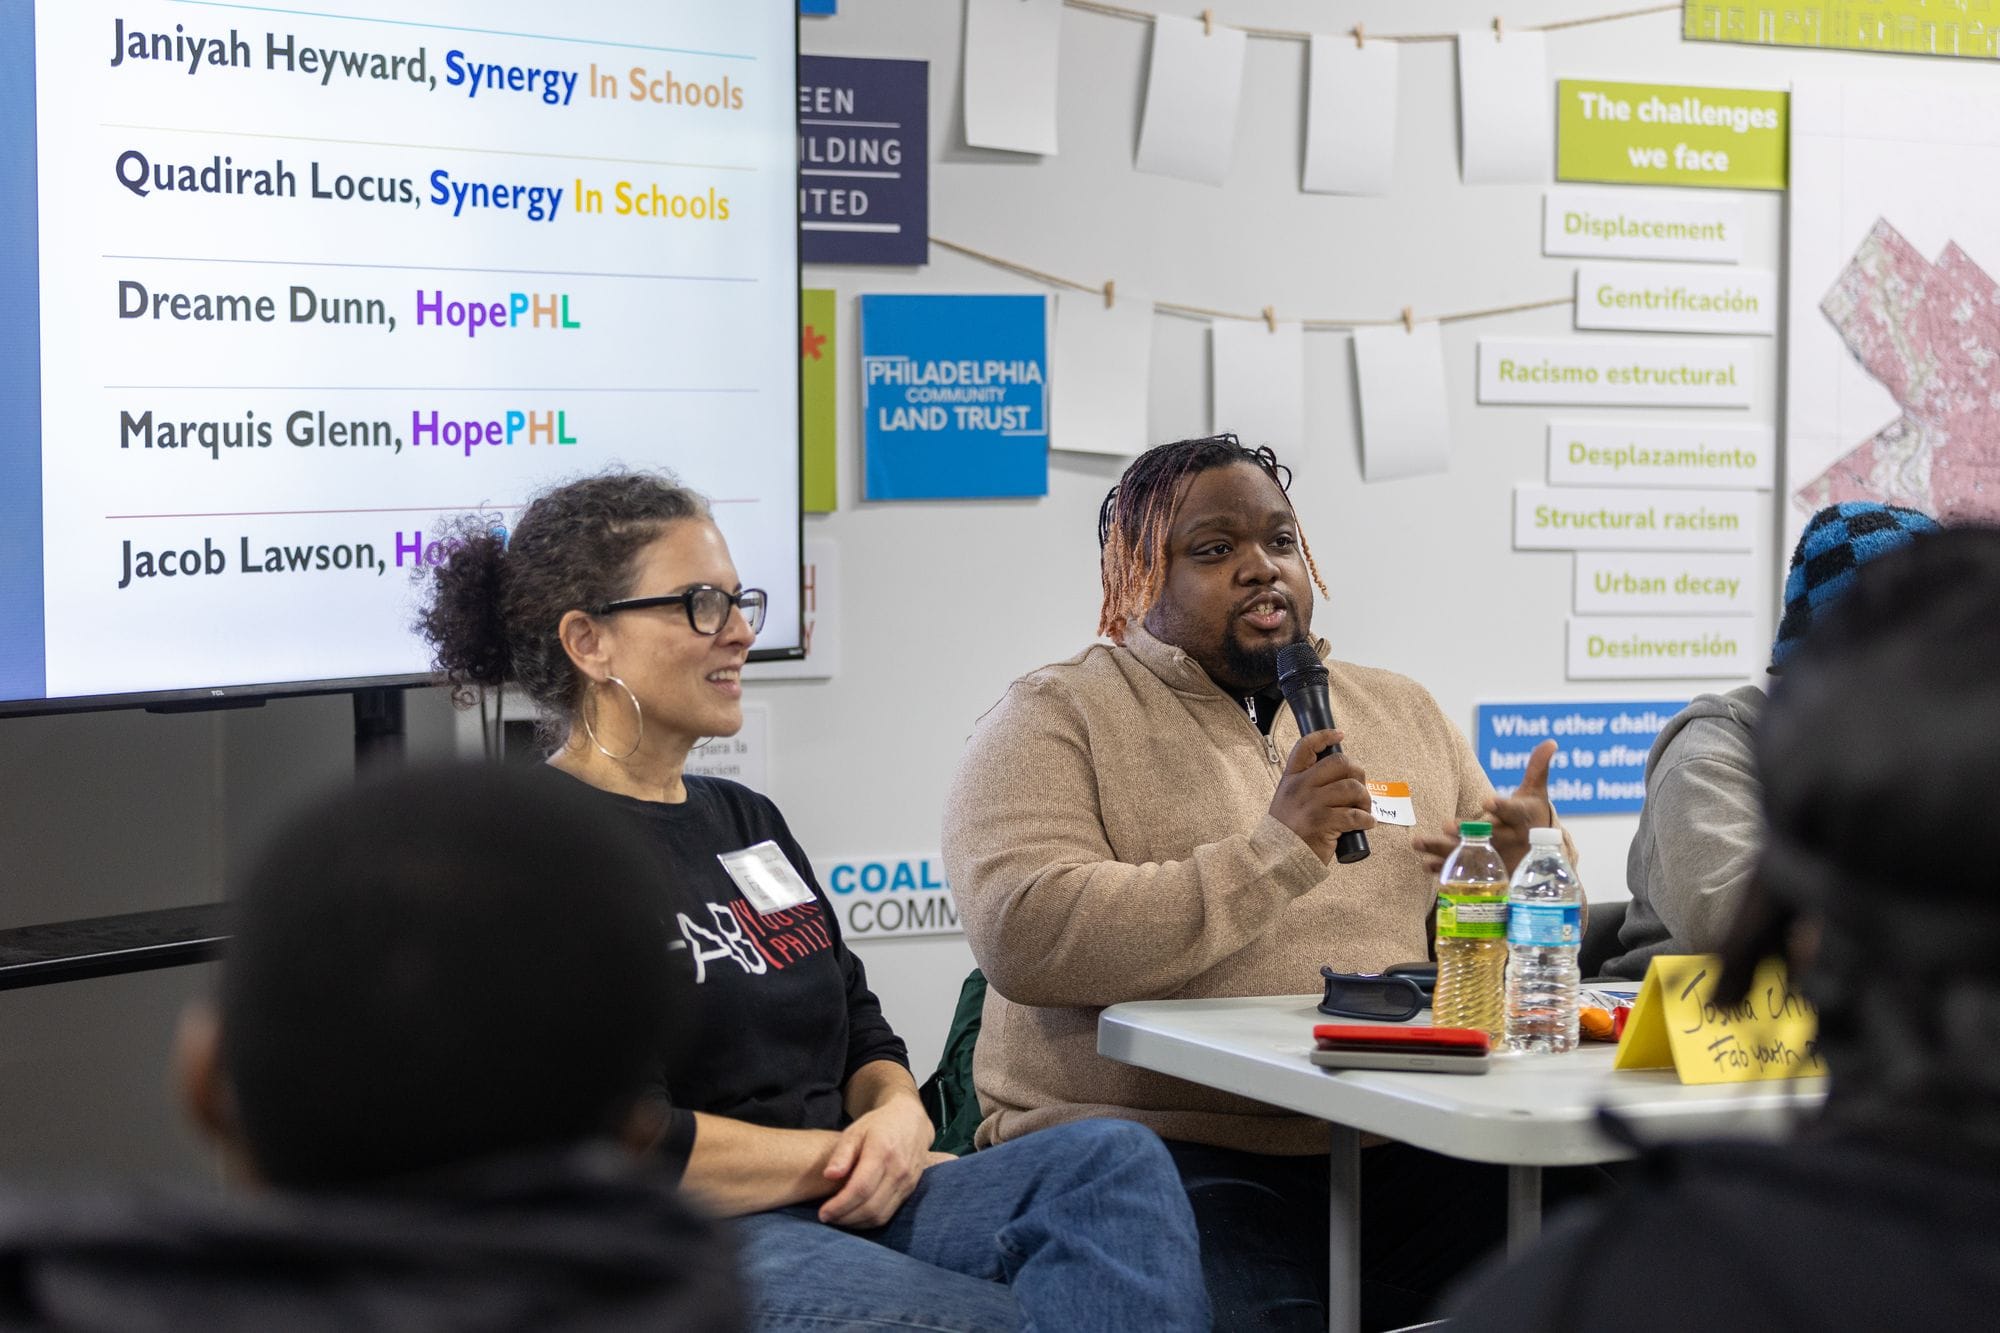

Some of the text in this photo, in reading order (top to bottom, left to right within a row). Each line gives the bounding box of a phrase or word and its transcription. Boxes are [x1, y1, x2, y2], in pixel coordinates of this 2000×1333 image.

[111, 18, 743, 110] Janiyah Heyward, Synergy In Schools
[1578, 92, 1778, 131] The challenges
[1628, 142, 1730, 172] we face
[115, 150, 729, 222] Quadirah Locus, Synergy In Schools
[1564, 212, 1726, 242] Displacement
[118, 280, 581, 338] Dreame Dunn, HopePHL
[1596, 285, 1759, 313] Gentrificación
[868, 360, 1043, 386] PHILADELPHIA
[1499, 359, 1736, 387] Racismo estructural
[905, 387, 1007, 404] COMMUNITY
[880, 406, 1031, 431] LAND TRUST
[119, 409, 577, 460] Marquis Glenn, HopePHL
[1567, 442, 1757, 471] Desplazamiento
[1534, 506, 1740, 531] Structural racism
[118, 537, 226, 589] Jacob
[240, 536, 386, 577] Lawson,
[1594, 571, 1740, 599] Urban decay
[1587, 633, 1737, 659] Desinversión
[1492, 714, 1549, 736] What
[1553, 712, 1608, 735] other
[1572, 748, 1594, 768] to
[830, 860, 950, 895] COAL
